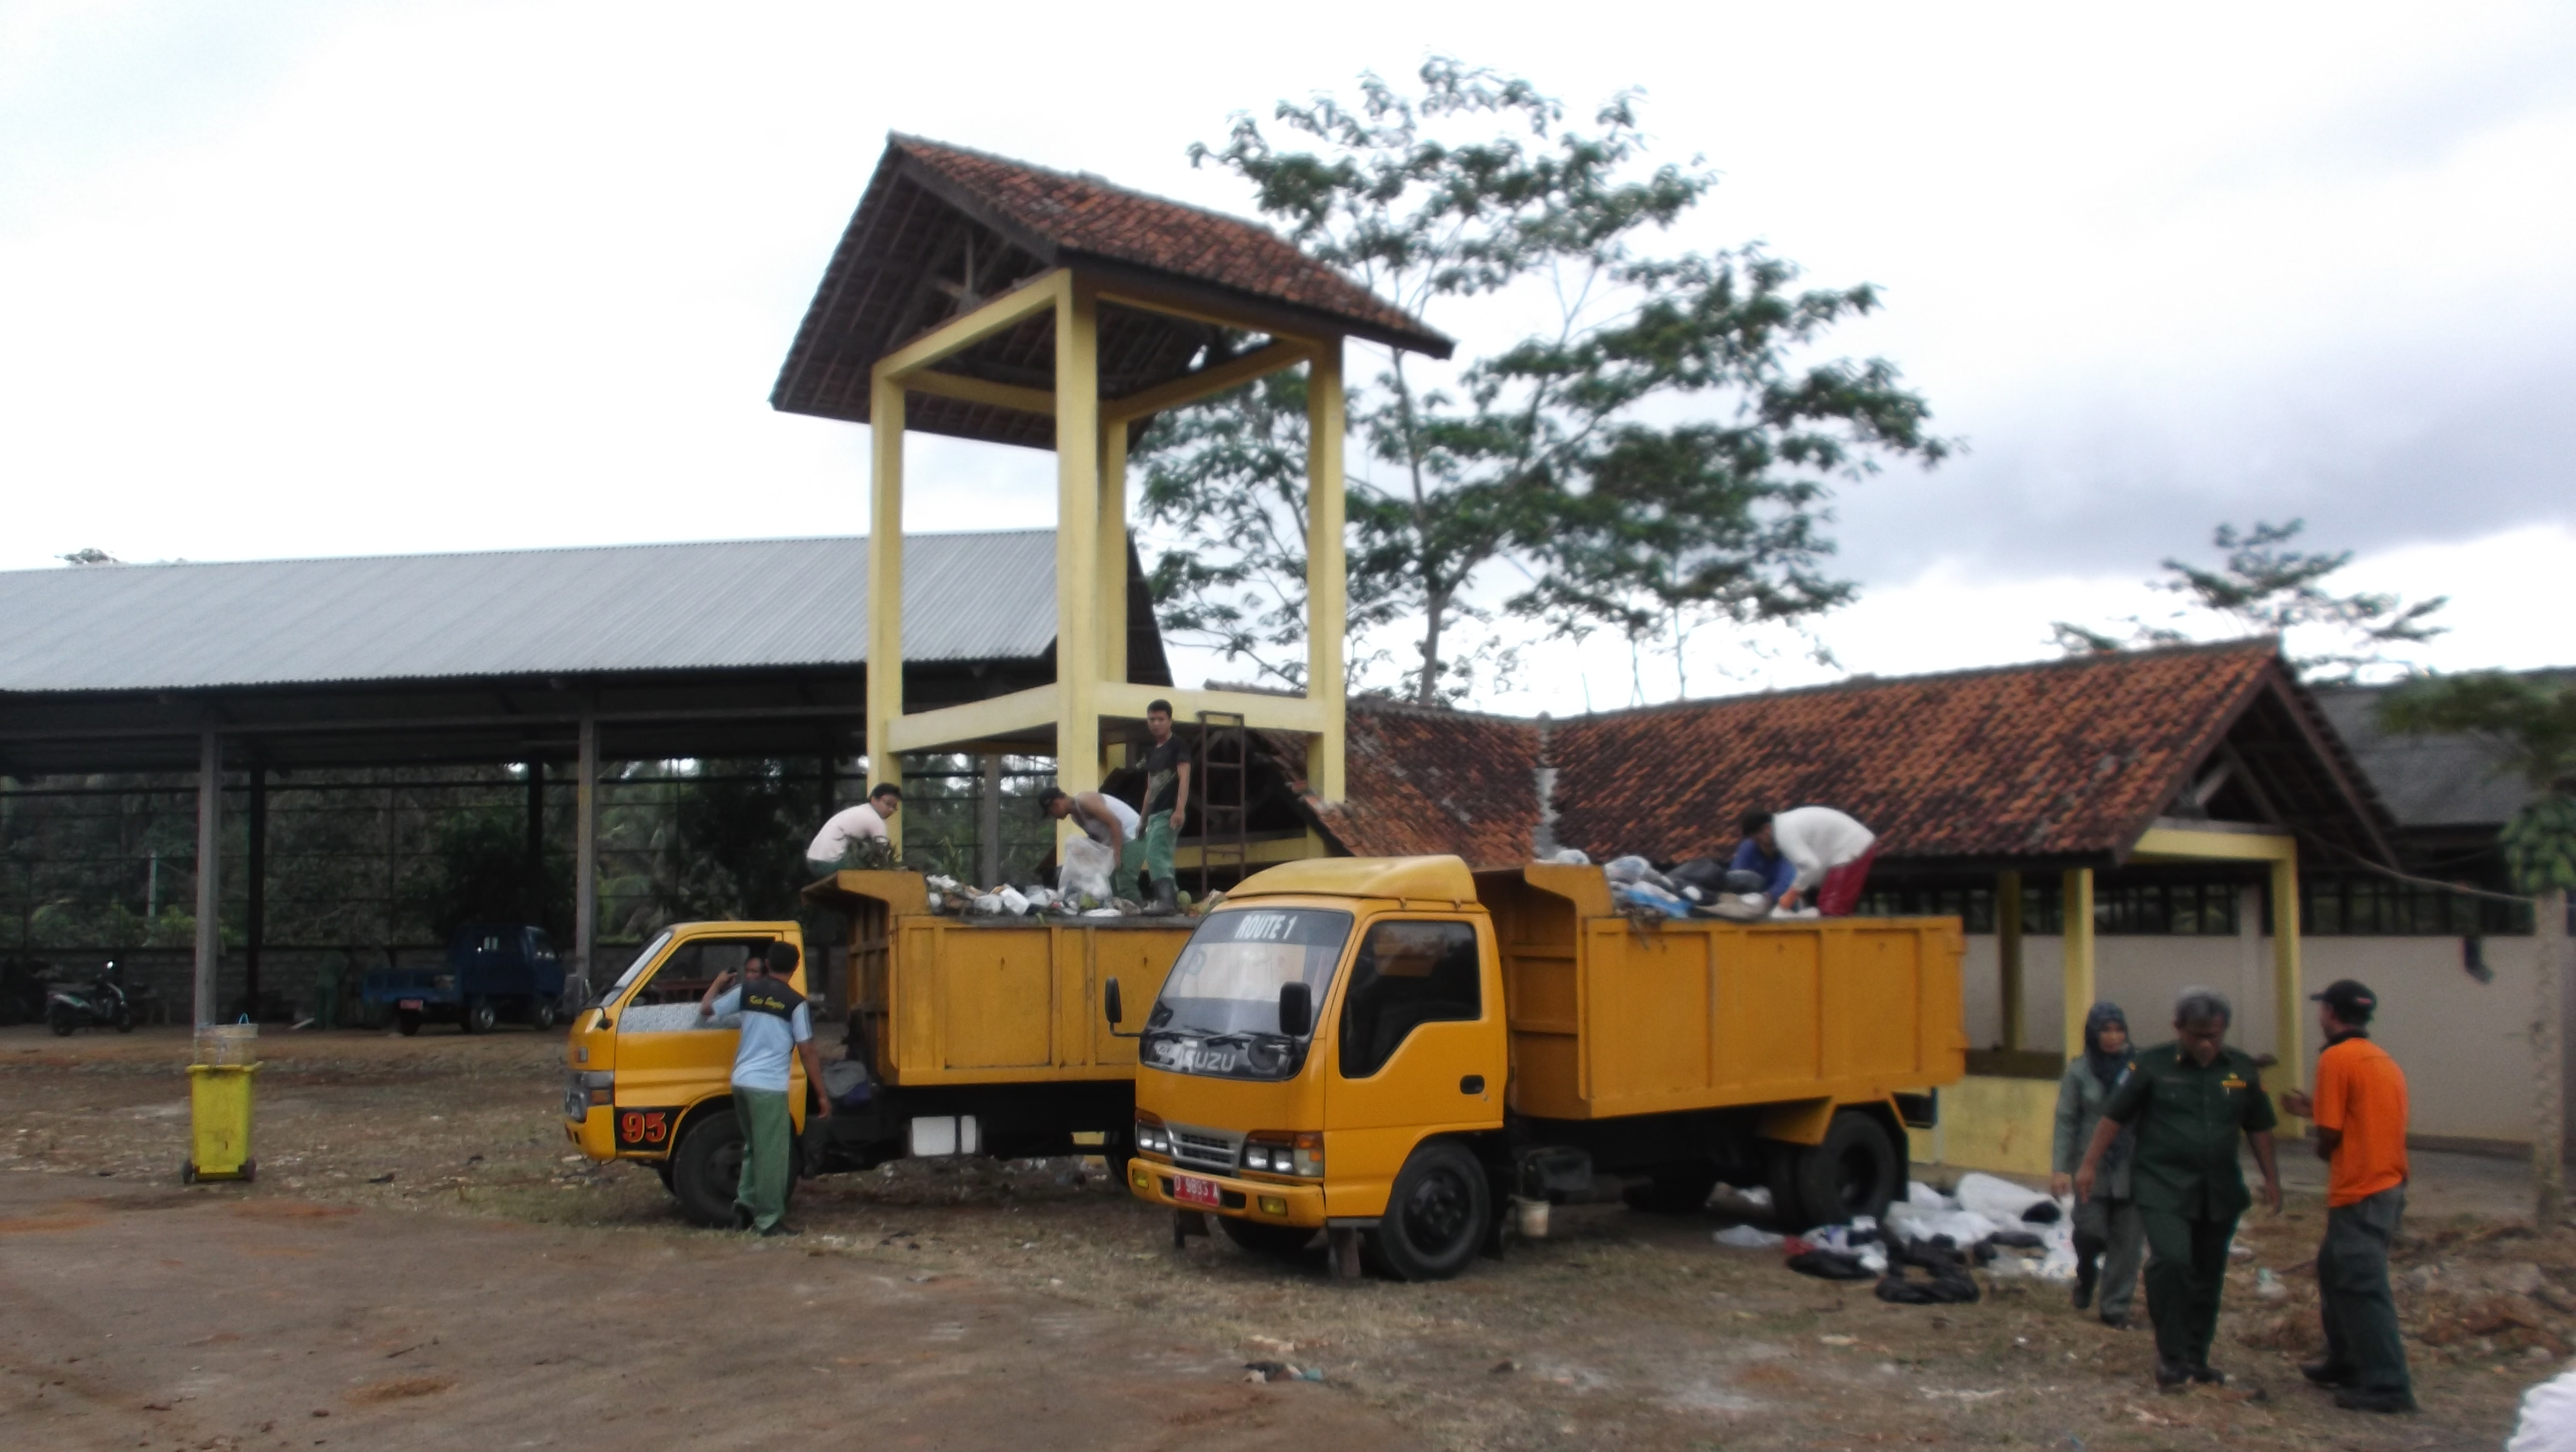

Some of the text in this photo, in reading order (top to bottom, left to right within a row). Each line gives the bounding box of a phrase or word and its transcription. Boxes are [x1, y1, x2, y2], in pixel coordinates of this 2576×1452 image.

[1234, 914, 1298, 940] ROUTE 1
[622, 1112, 666, 1143] 95
